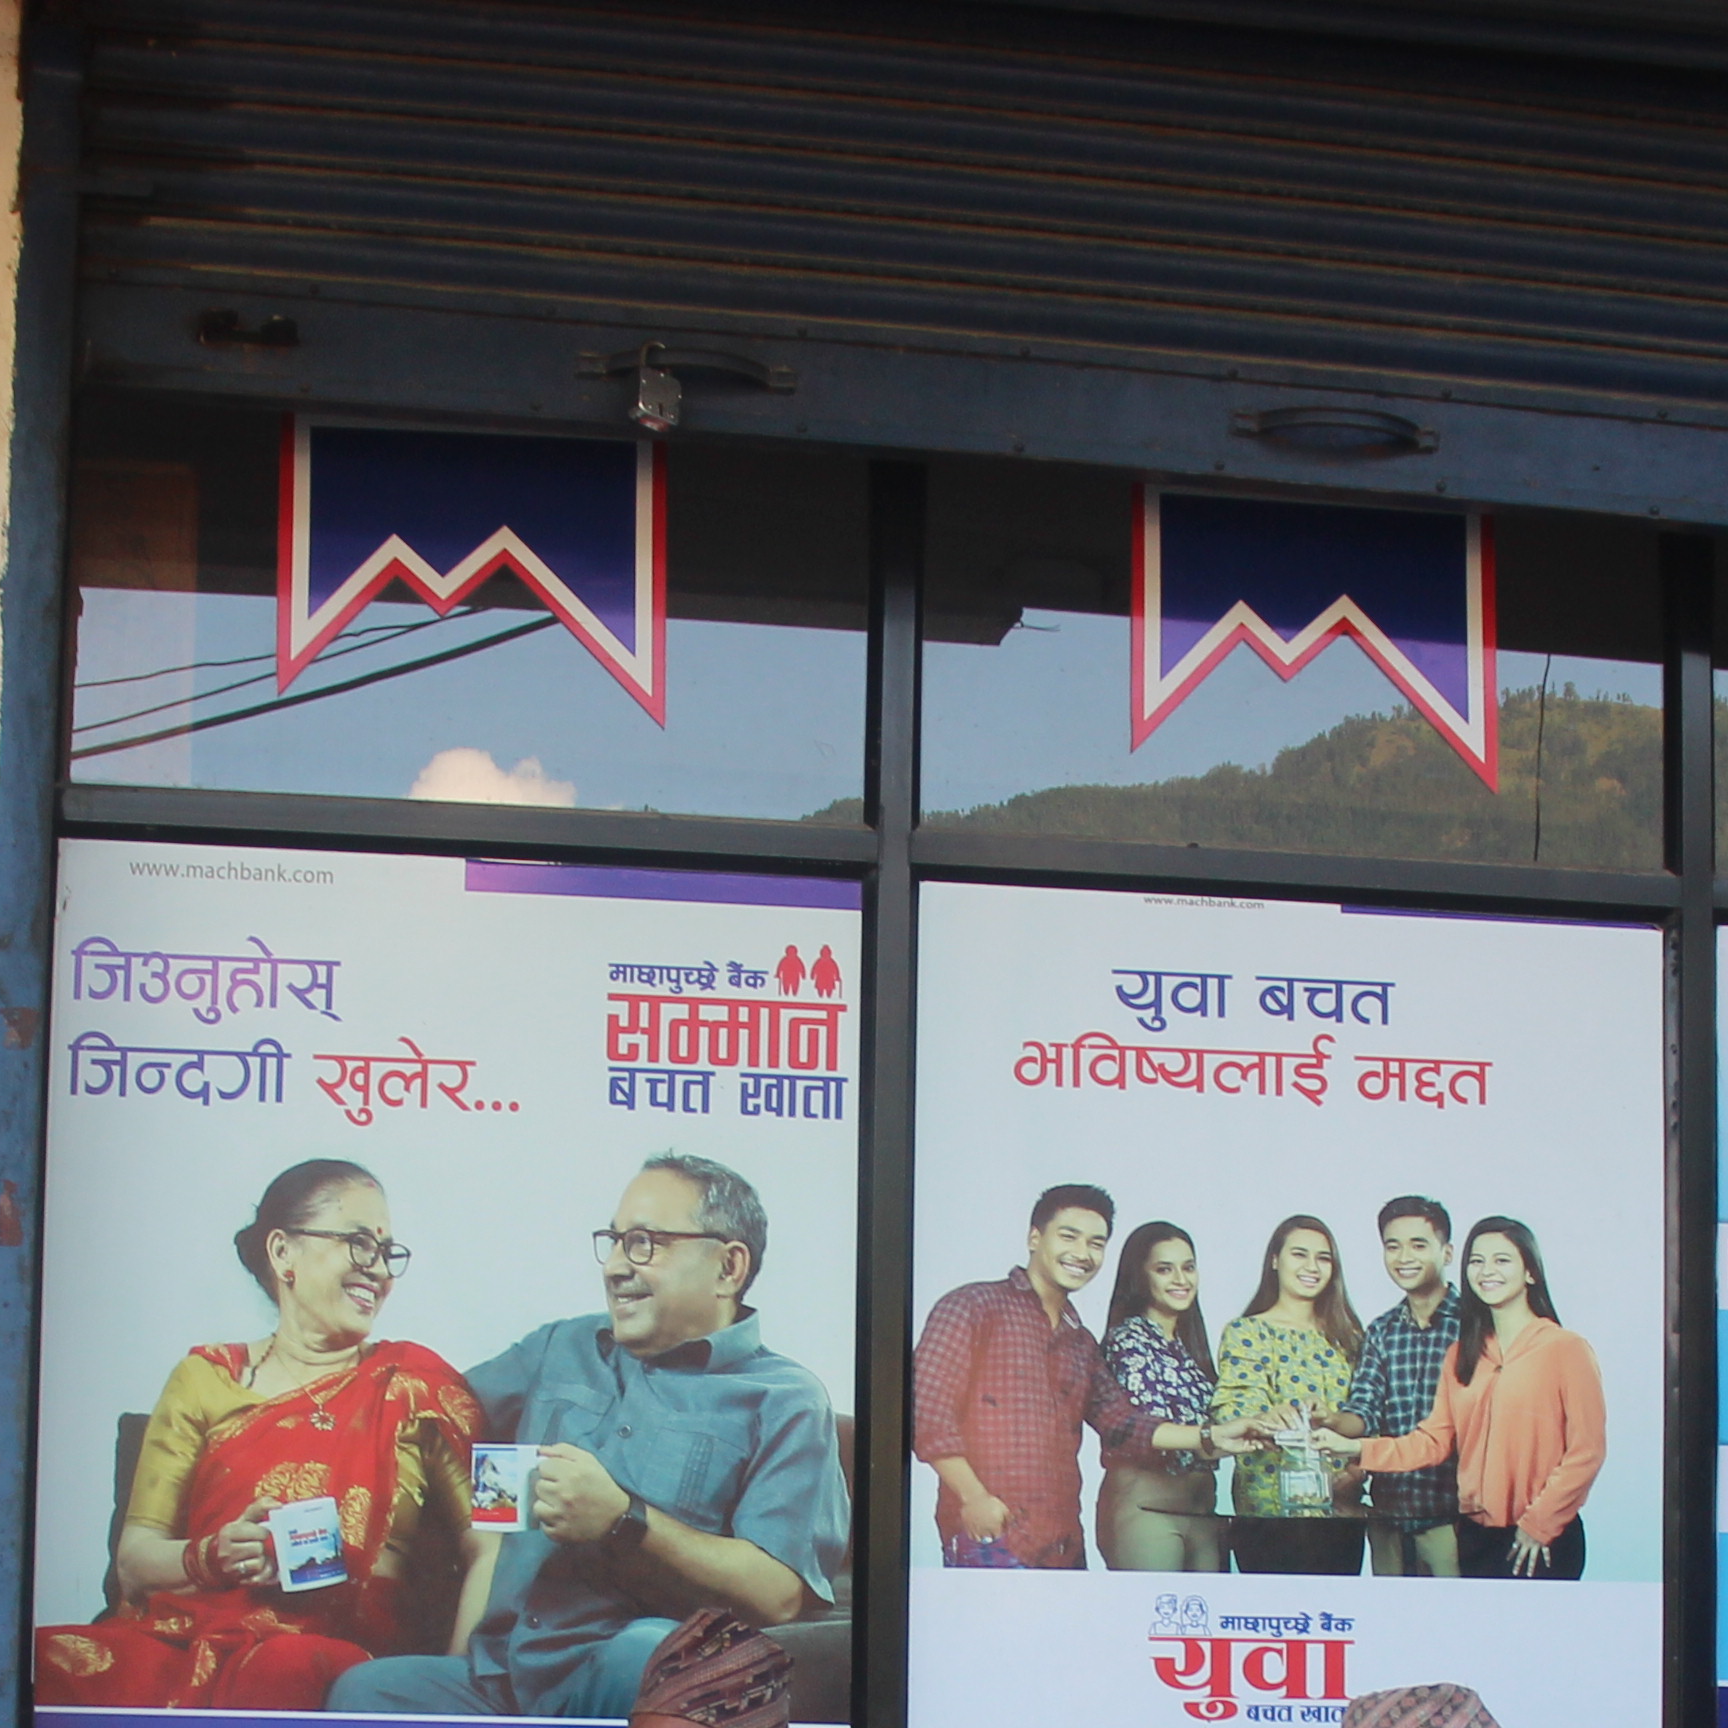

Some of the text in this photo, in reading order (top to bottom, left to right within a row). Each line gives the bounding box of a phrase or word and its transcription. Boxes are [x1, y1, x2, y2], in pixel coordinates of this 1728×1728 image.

[129, 860, 334, 884] www.machbank.com
[1143, 896, 1265, 909] www.machbank.com
[71, 936, 342, 1025] जिउनुहोस्
[608, 960, 769, 994] माछापुच्छ्रे बैंक
[1112, 969, 1395, 1032] युवा बचत
[607, 993, 847, 1071] सम्मान
[68, 1030, 520, 1127] जिन्दगी खुलेर...
[608, 1066, 848, 1120] बचत खाता
[1013, 1031, 1493, 1109] भविष्यलाई मद्दत
[1320, 1612, 1355, 1632] बैंक
[1148, 1637, 1356, 1721] युवा
[1246, 1704, 1293, 1723] बचत
